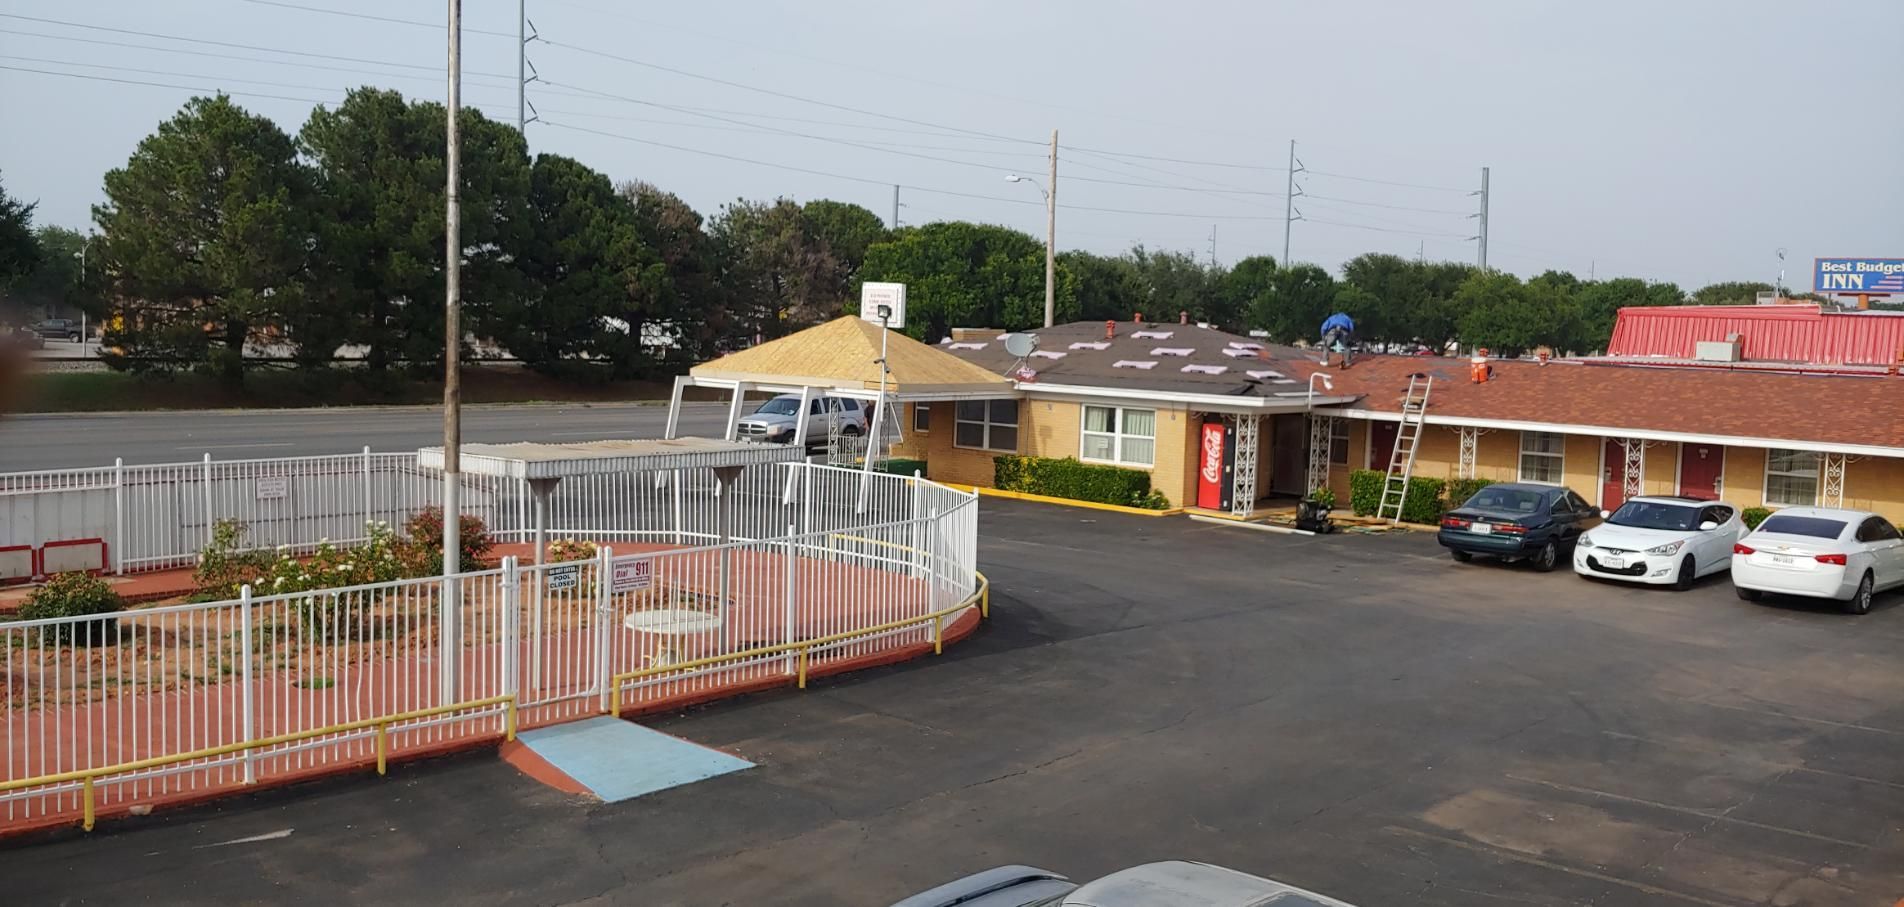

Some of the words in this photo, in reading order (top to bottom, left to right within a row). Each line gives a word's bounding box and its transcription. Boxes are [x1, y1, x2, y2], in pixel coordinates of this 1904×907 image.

[1822, 262, 1853, 272] Best
[1822, 274, 1864, 289] INN
[615, 570, 629, 578] Dial
[635, 561, 649, 576] 911
[550, 580, 576, 588] CLOSED
